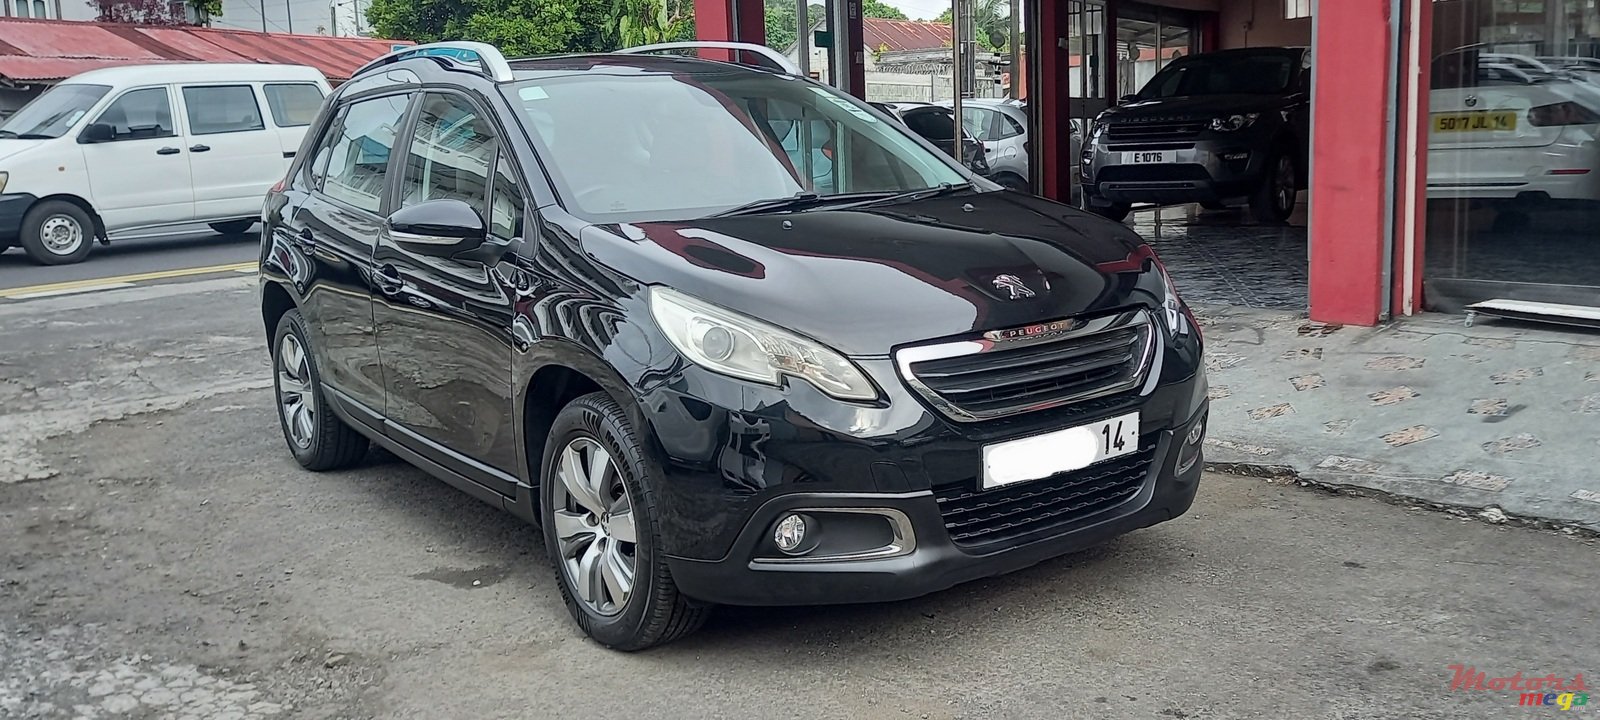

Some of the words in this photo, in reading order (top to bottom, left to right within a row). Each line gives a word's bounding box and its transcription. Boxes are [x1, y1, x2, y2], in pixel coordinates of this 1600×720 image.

[1472, 116, 1487, 129] JL
[1494, 115, 1508, 127] 14
[1134, 153, 1140, 163] E
[1141, 152, 1162, 162] 1076
[1009, 322, 1065, 337] PEUGEOT
[1102, 420, 1125, 455] 14
